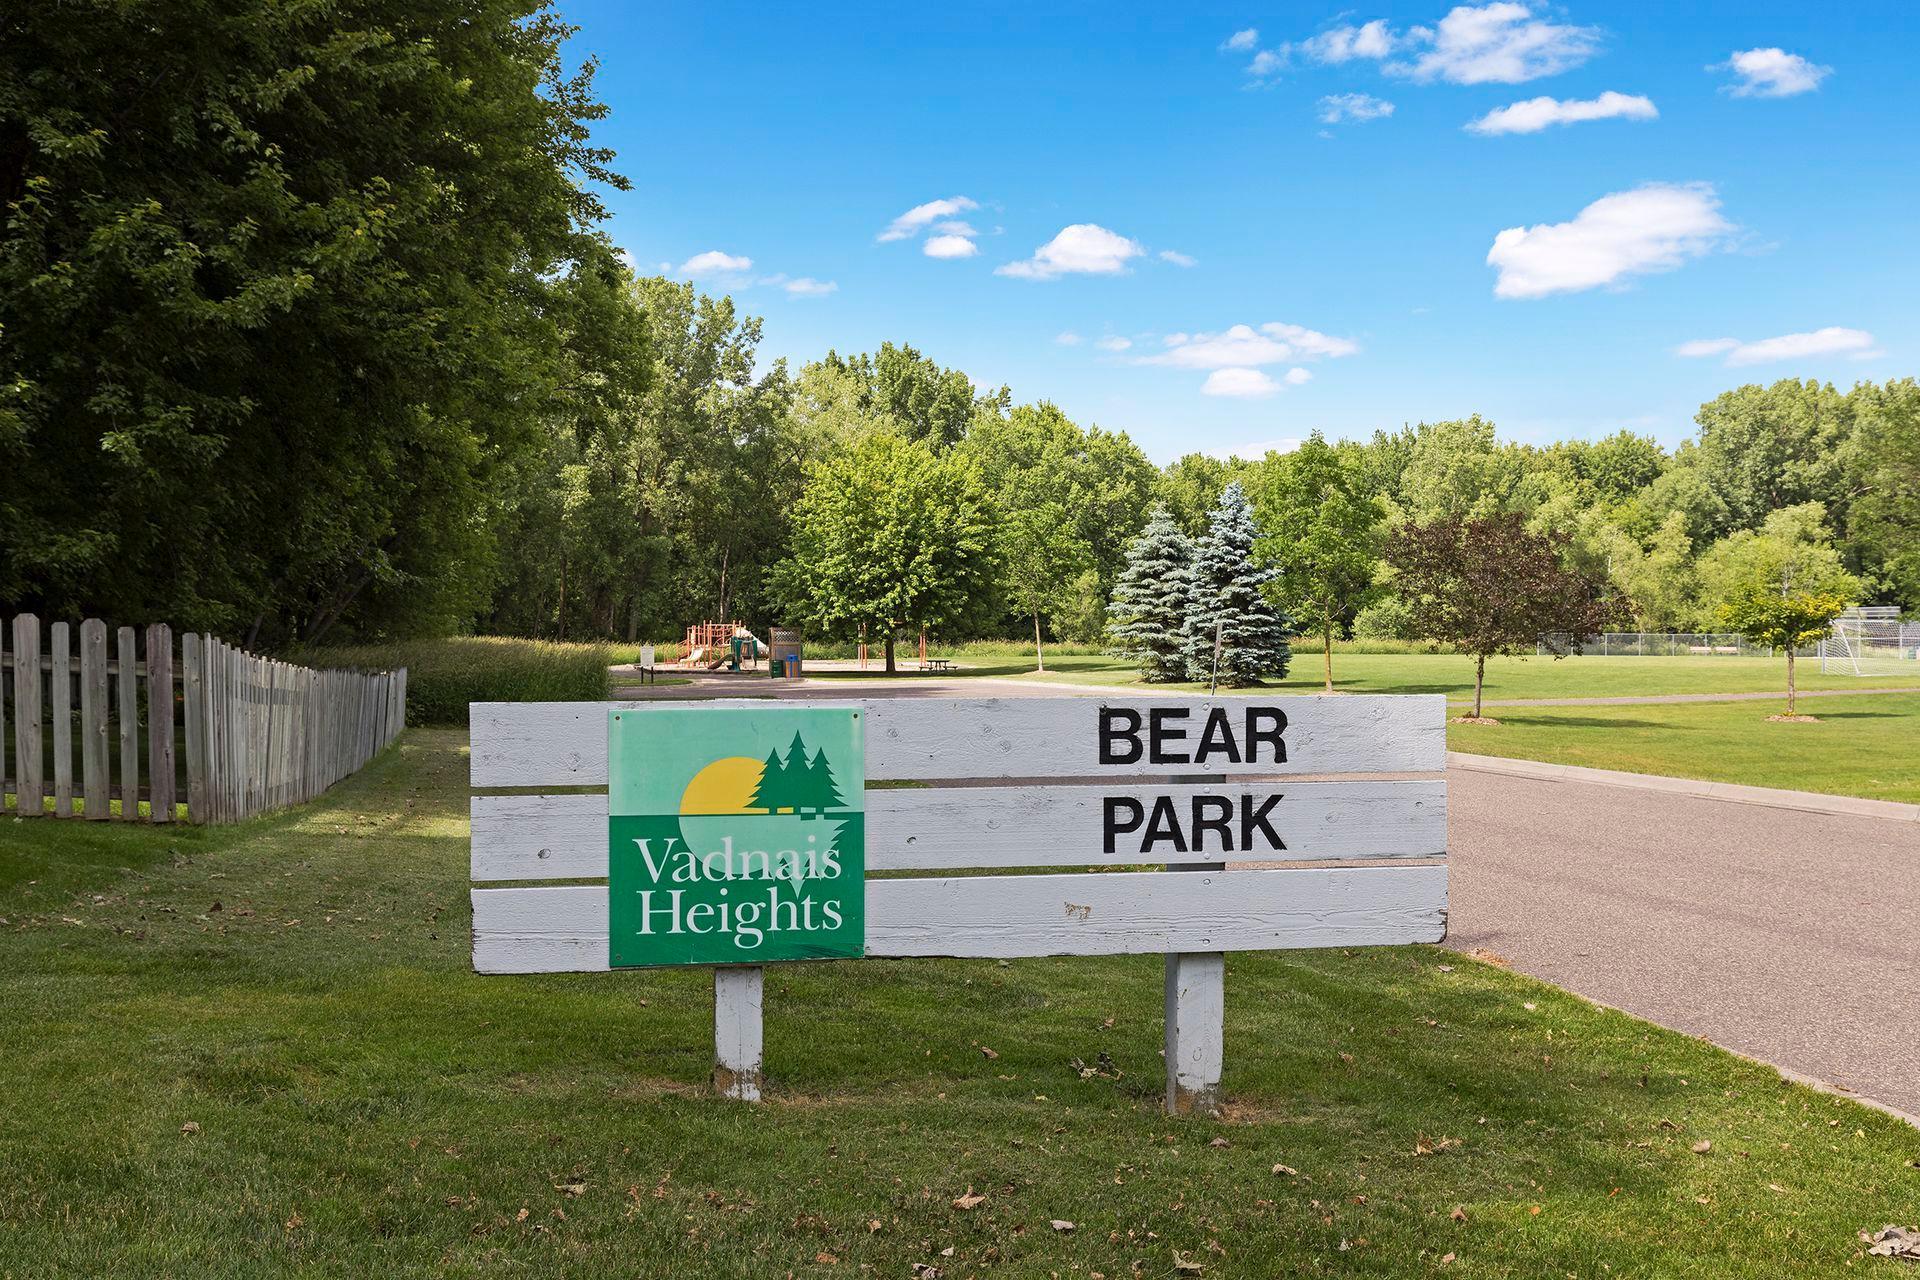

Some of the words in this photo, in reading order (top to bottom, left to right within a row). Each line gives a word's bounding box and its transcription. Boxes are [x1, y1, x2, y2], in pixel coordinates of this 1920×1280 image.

[1099, 707, 1288, 764] BEAR
[1103, 794, 1288, 854] PARK
[632, 836, 842, 883] Vadnais
[636, 886, 843, 949] Heights
